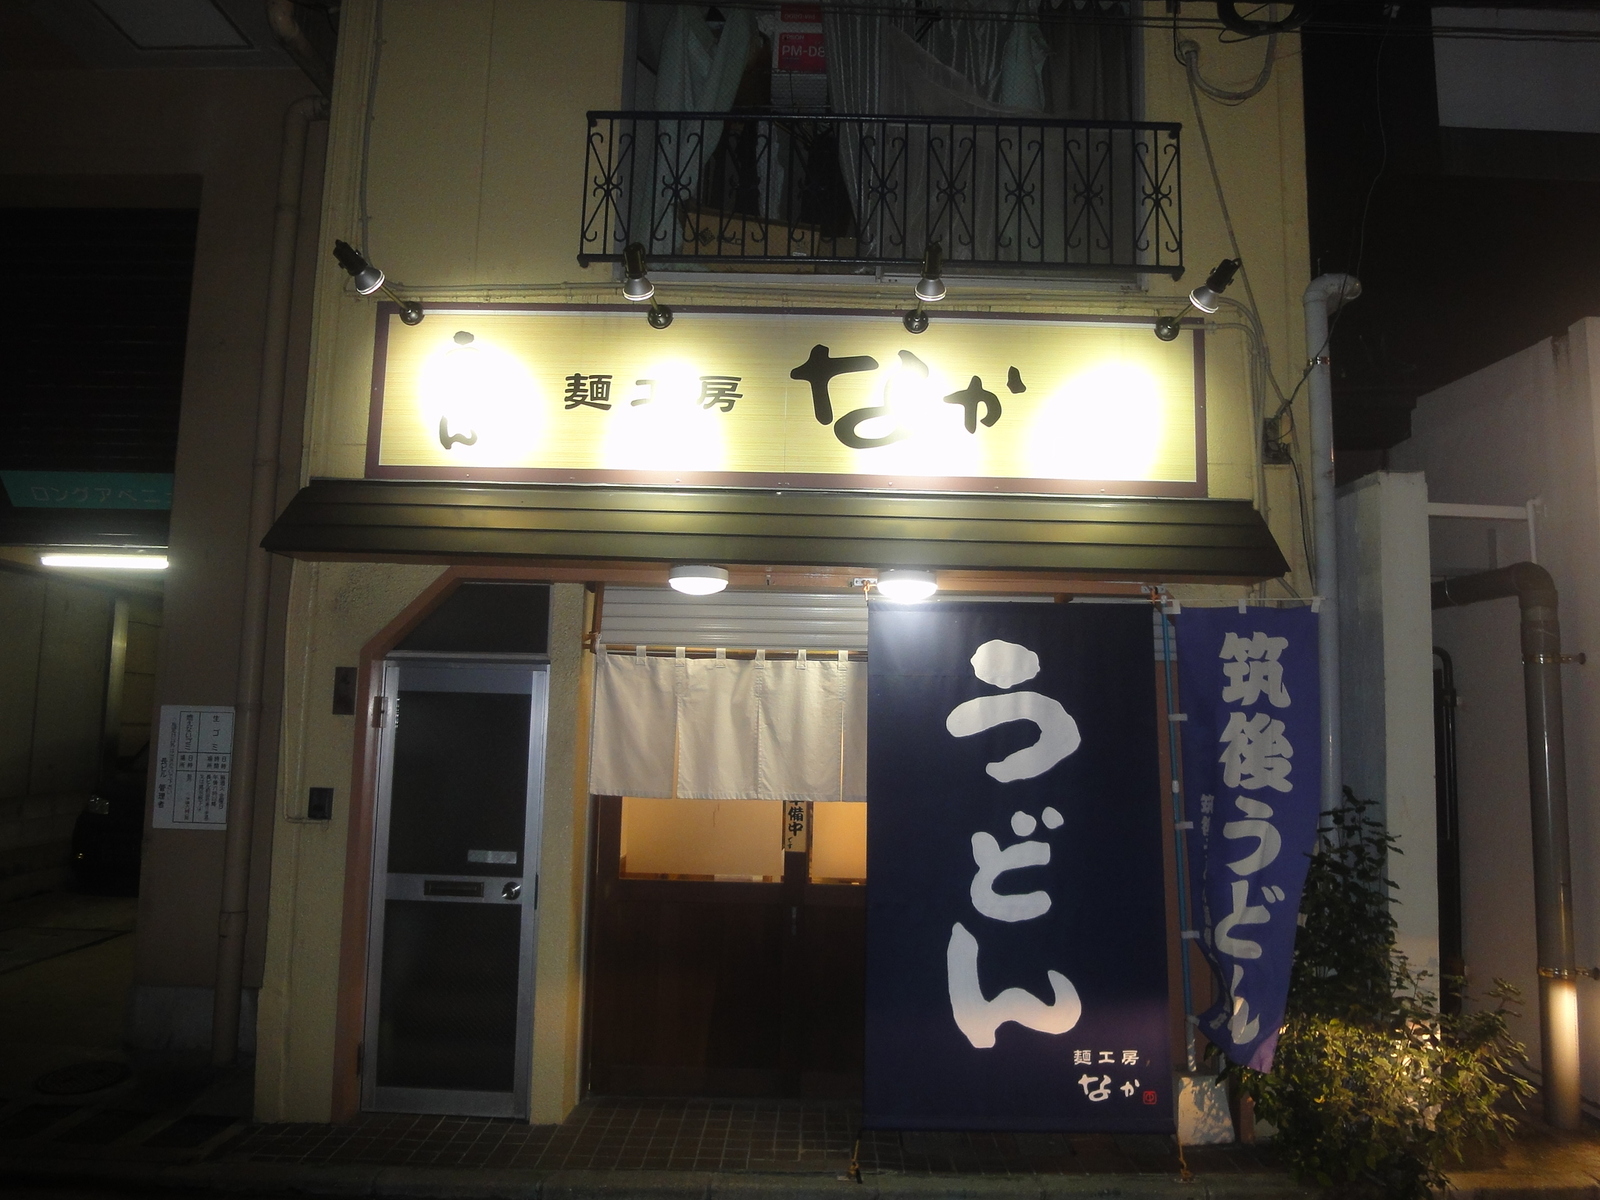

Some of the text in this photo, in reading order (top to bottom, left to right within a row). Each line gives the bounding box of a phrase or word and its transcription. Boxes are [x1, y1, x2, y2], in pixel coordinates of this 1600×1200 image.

[789, 343, 1028, 450] なか
[30, 486, 173, 503] ロングアベニ
[788, 801, 805, 837] 備中
[945, 638, 1082, 1049] うどん
[1213, 631, 1294, 1045] 筑後うどん
[1073, 1049, 1140, 1066] 麺工房
[1077, 1074, 1141, 1102] なか
